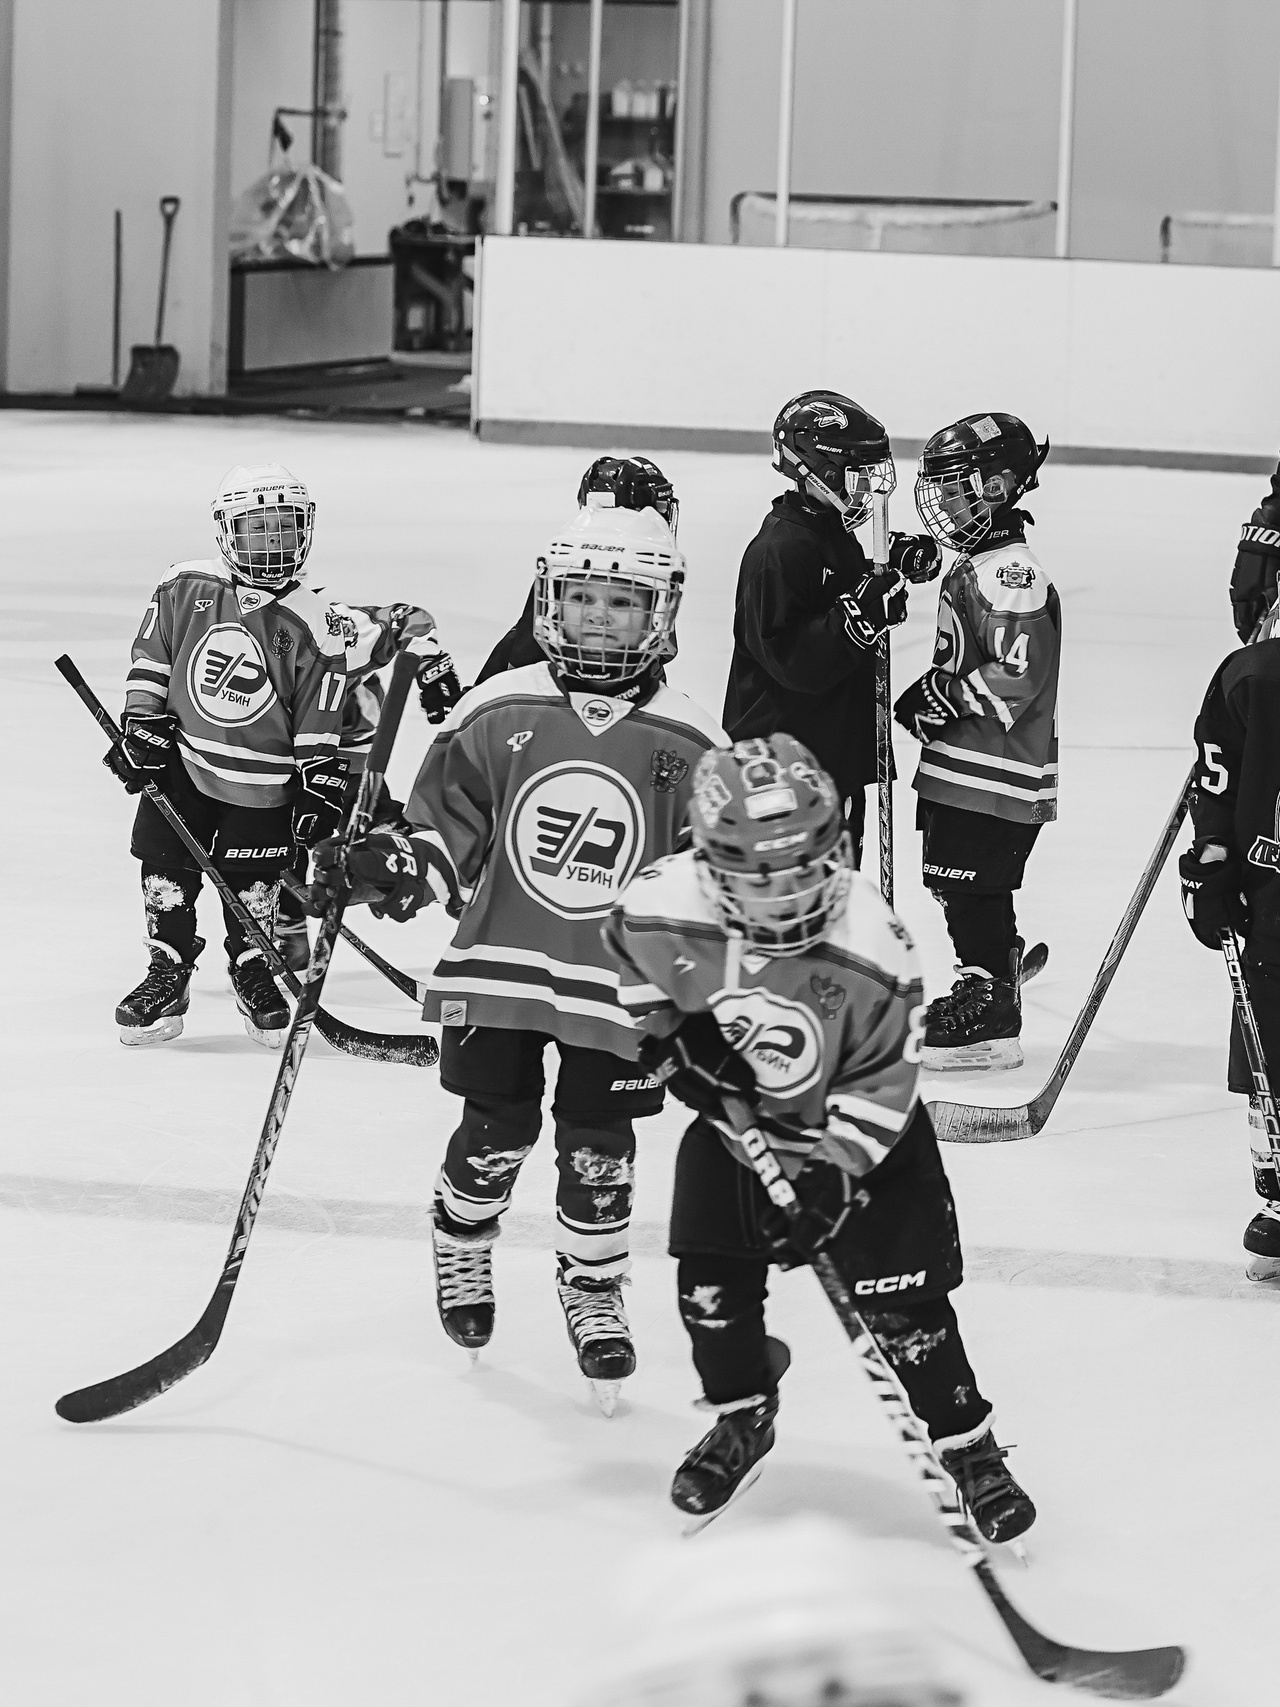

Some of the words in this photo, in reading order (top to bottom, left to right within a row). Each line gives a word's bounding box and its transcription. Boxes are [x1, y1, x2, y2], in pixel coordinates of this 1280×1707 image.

[252, 485, 285, 493] BAUER
[580, 543, 626, 553] BAUER
[992, 625, 1031, 675] 14
[220, 688, 251, 708] УБИН
[317, 671, 346, 712] 17
[224, 845, 289, 860] BAUER
[565, 864, 614, 889] УБИН
[923, 863, 977, 881] BAUER
[203, 865, 282, 967] FISCHER
[755, 1050, 792, 1074] БИН
[610, 1077, 662, 1092] BAUE
[854, 1270, 927, 1296] CCM
